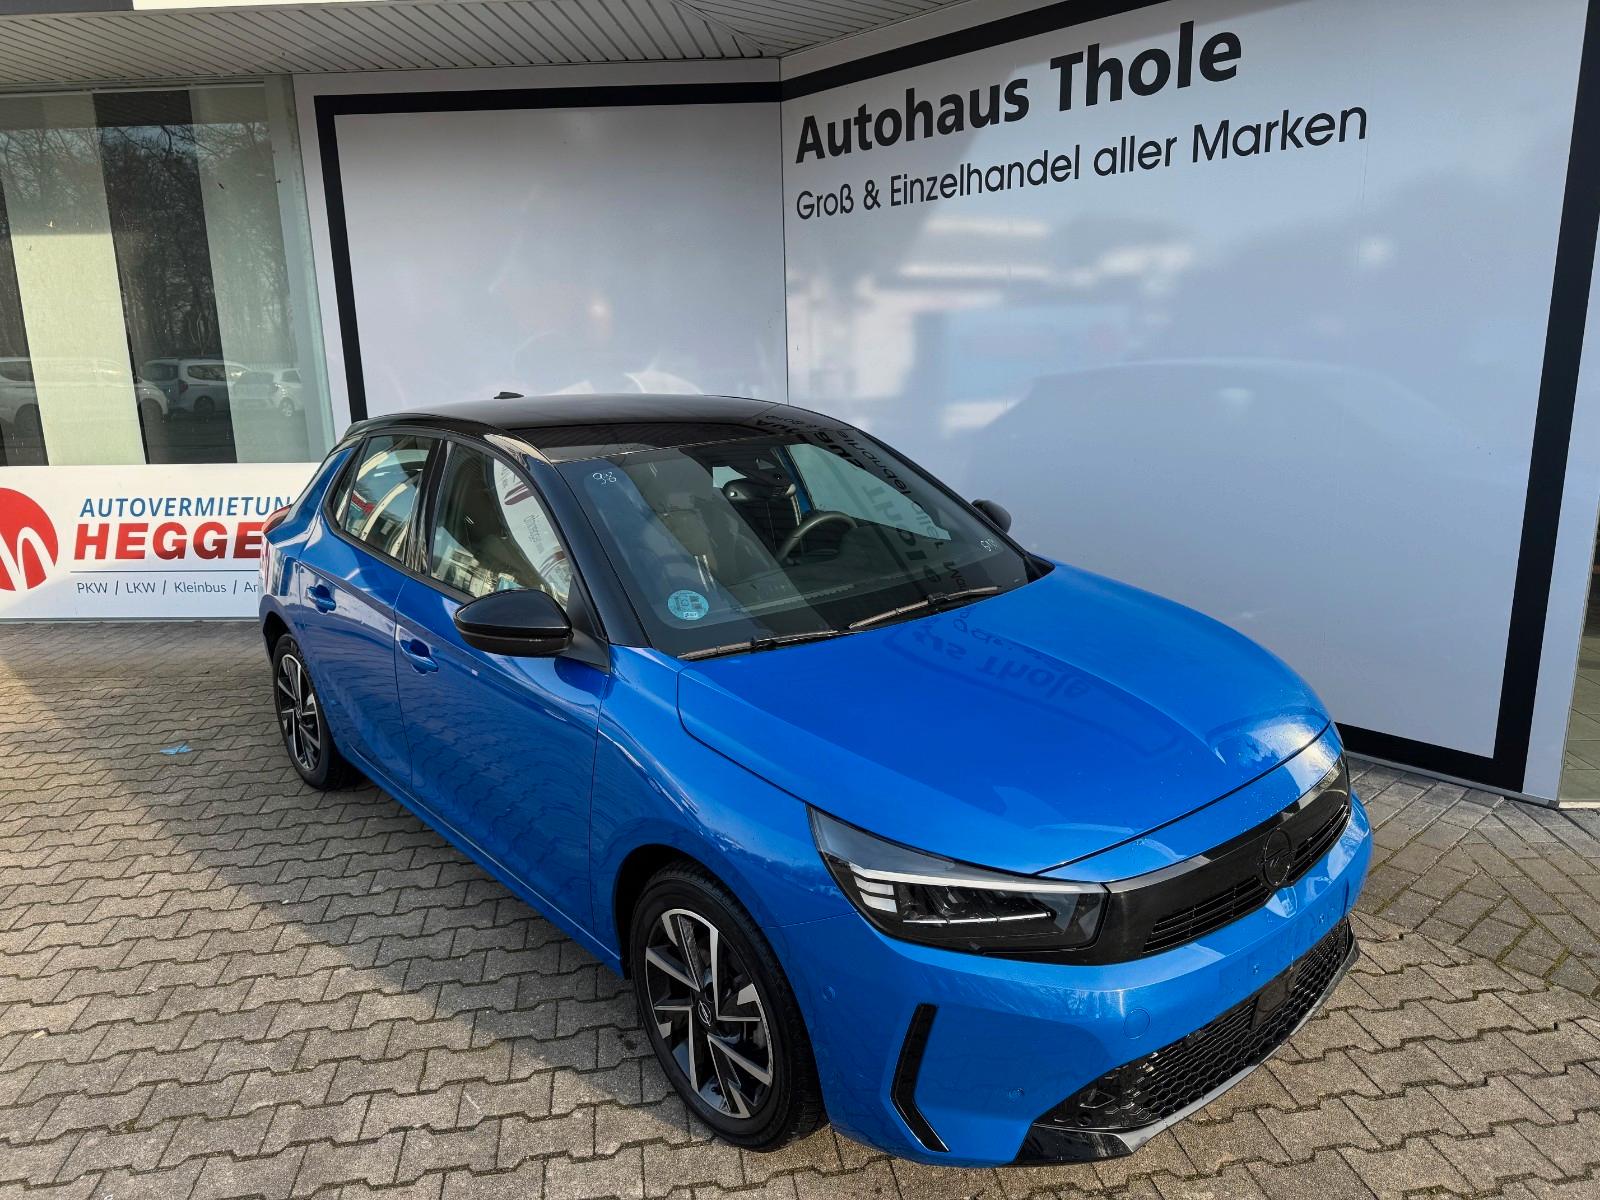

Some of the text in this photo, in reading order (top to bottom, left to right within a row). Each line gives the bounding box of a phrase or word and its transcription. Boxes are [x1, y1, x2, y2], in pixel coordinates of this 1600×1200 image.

[796, 20, 1241, 163] Autohaus Thole
[797, 105, 1367, 220] Groß & Einzelhandel aller Marken
[74, 521, 264, 560] HEGGE
[77, 582, 108, 593] PKW
[126, 582, 156, 593] LKW
[174, 581, 227, 593] Kleinbus
